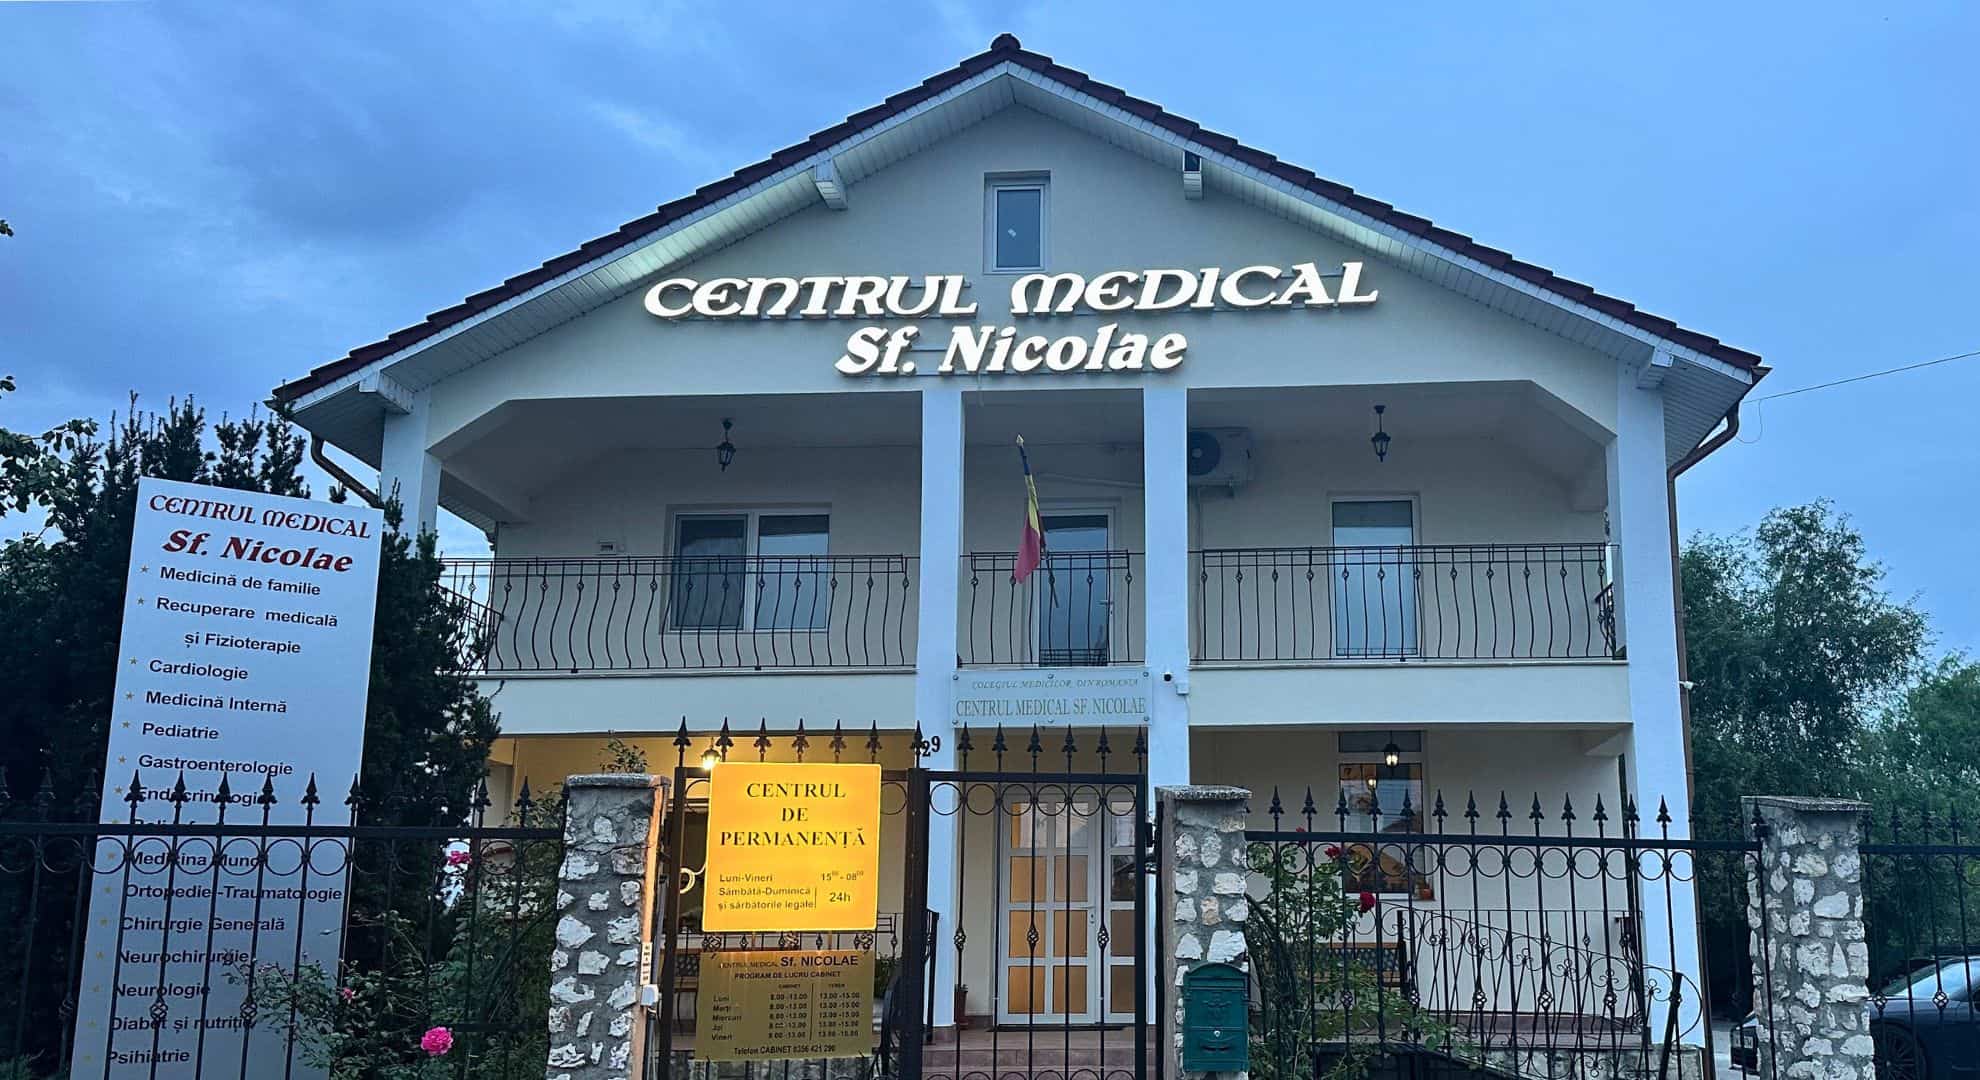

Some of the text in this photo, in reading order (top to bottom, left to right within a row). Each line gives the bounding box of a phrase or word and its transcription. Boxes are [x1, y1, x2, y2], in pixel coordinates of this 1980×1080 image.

[644, 262, 1379, 319] CENTRUL MEDICAL
[834, 323, 1189, 377] Sf. Nicolae
[149, 494, 371, 539] CENTRUL MEDICAL
[162, 529, 354, 573] Sf. Nicolae
[160, 566, 321, 596] Medicină de familie
[156, 596, 338, 627] Recuperare medicală
[204, 633, 301, 655] Fizioterapie
[149, 659, 249, 681] Cardiologie
[145, 690, 224, 709] Medicină
[956, 700, 1013, 716] CENTRUL
[1016, 699, 1070, 716] MEDICAL
[1093, 697, 1145, 714] NICOLAE
[142, 722, 219, 740] Pediatrie
[138, 754, 294, 777] Gastroenterologie
[746, 783, 846, 798] CENTRUL
[782, 807, 809, 821] DE
[719, 873, 773, 883] Luni-Vineri
[829, 892, 851, 903] 24h
[780, 956, 798, 967] Sf.
[801, 955, 859, 967] NICOLAE
[810, 970, 841, 978] CABINET
[760, 1045, 792, 1054] CABINET
